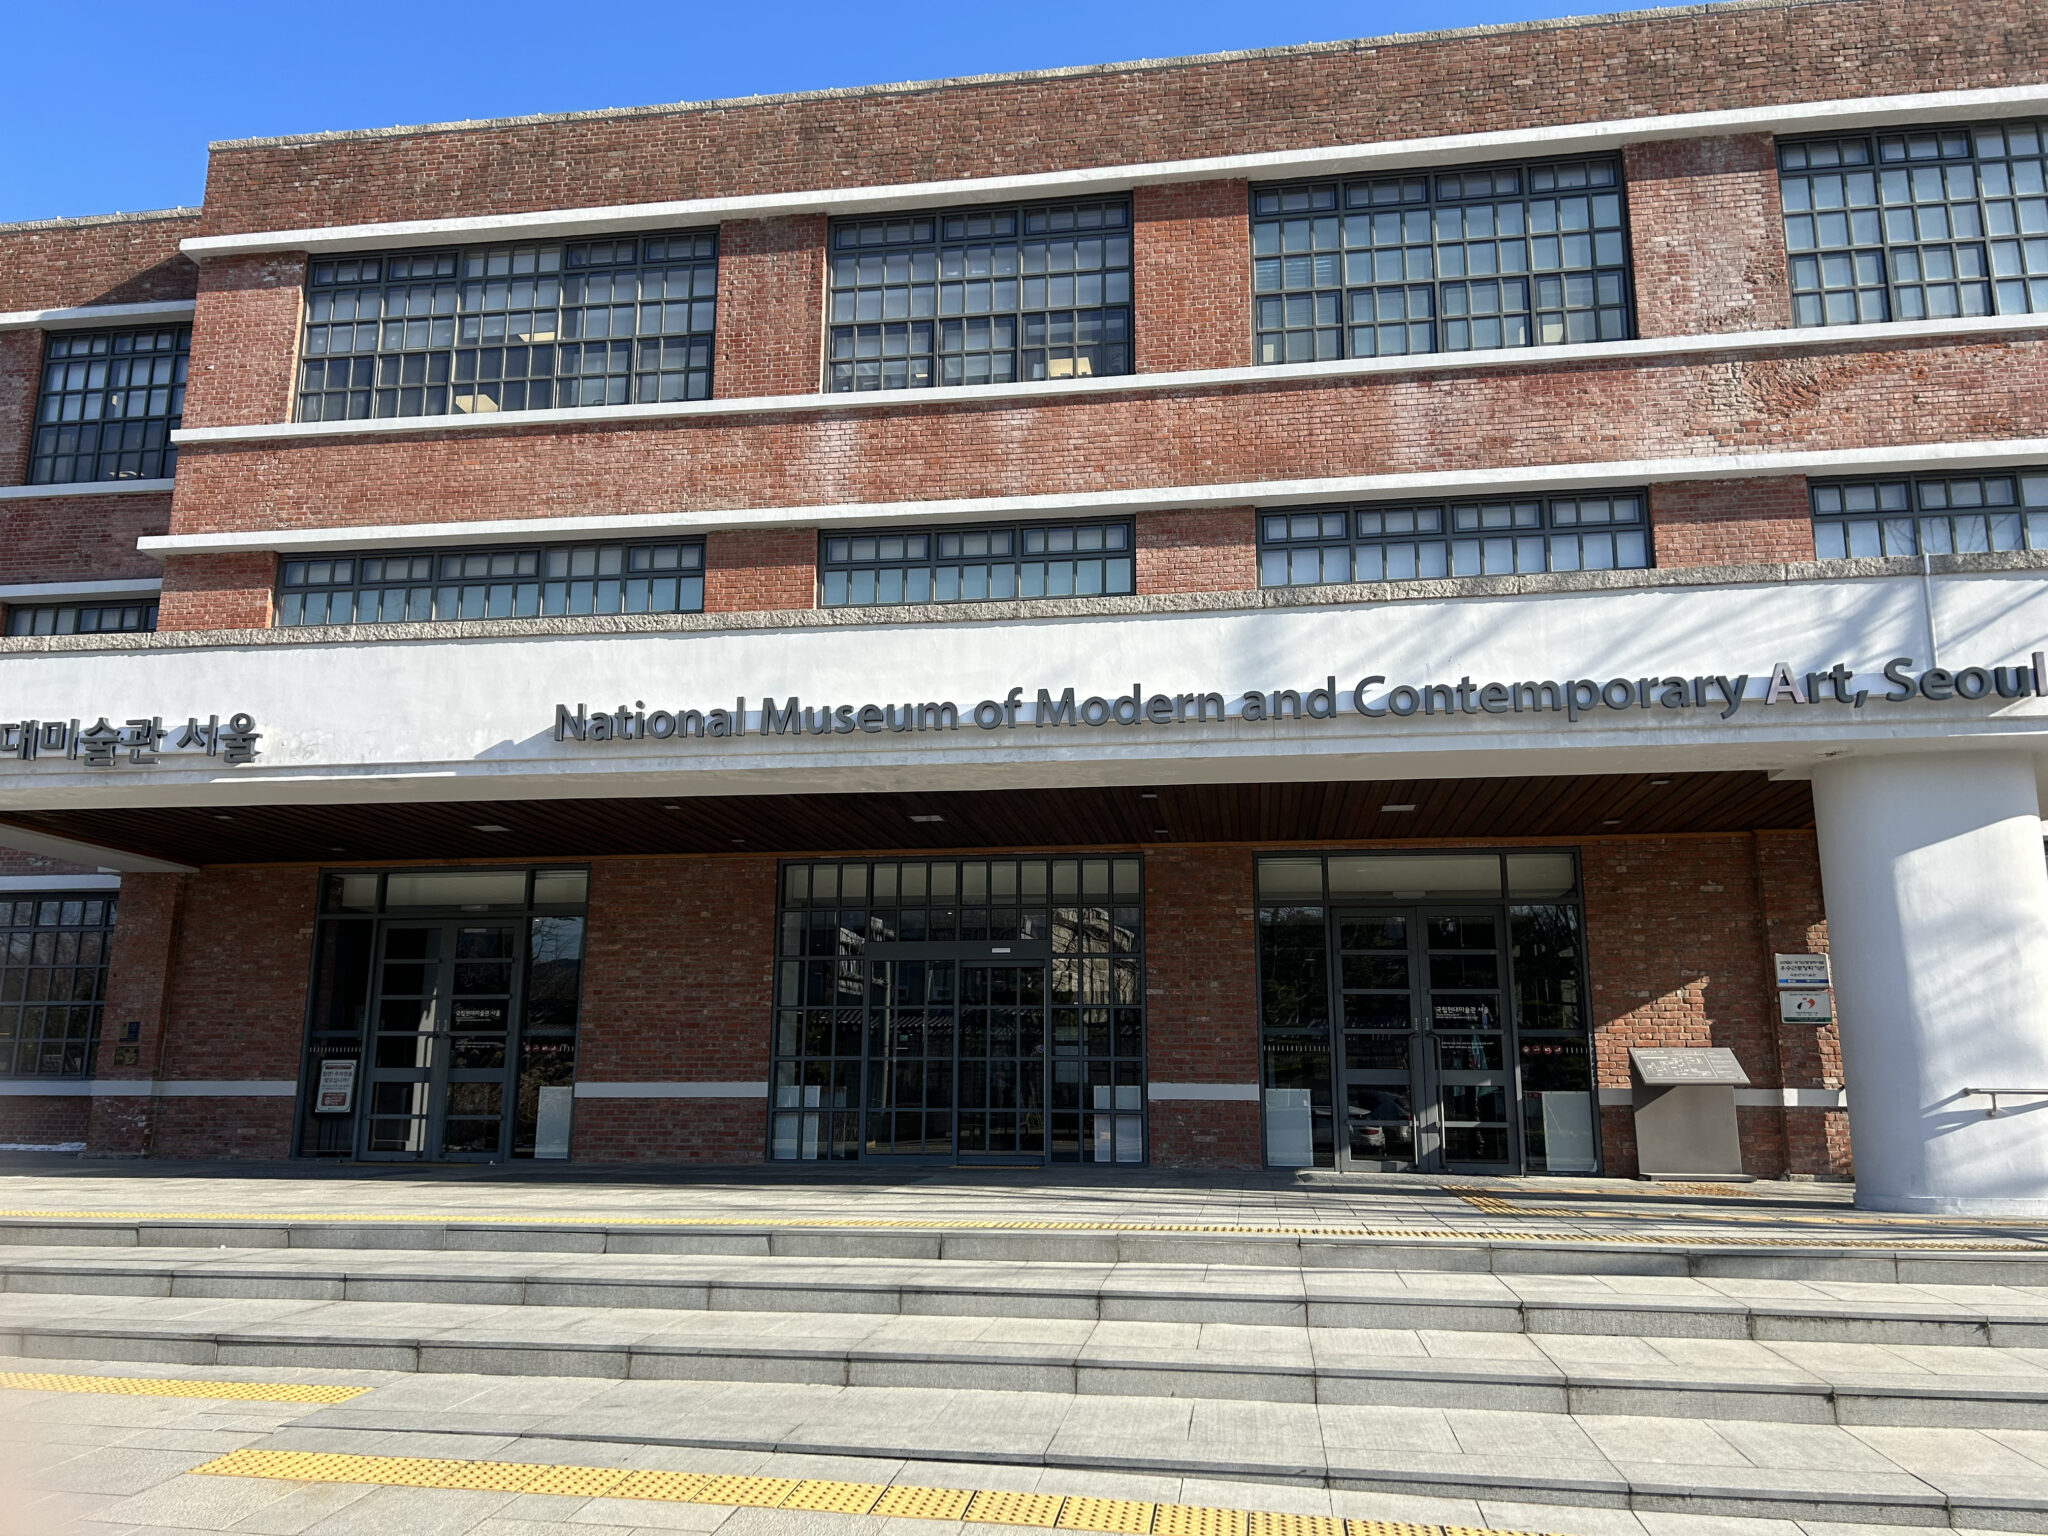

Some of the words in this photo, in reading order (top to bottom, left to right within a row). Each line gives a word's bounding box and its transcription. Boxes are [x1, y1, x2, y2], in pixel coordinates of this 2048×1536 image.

[554, 696, 746, 741] National
[760, 696, 959, 735] Museum
[973, 686, 1023, 729] of
[1035, 683, 1225, 728] Modern
[1241, 675, 1337, 721] and
[1353, 673, 1749, 722] Contemporary
[1764, 662, 1869, 708] Art,
[1883, 651, 2048, 702] Seoul
[0, 716, 168, 767] 대미술관
[177, 712, 263, 763] 서울
